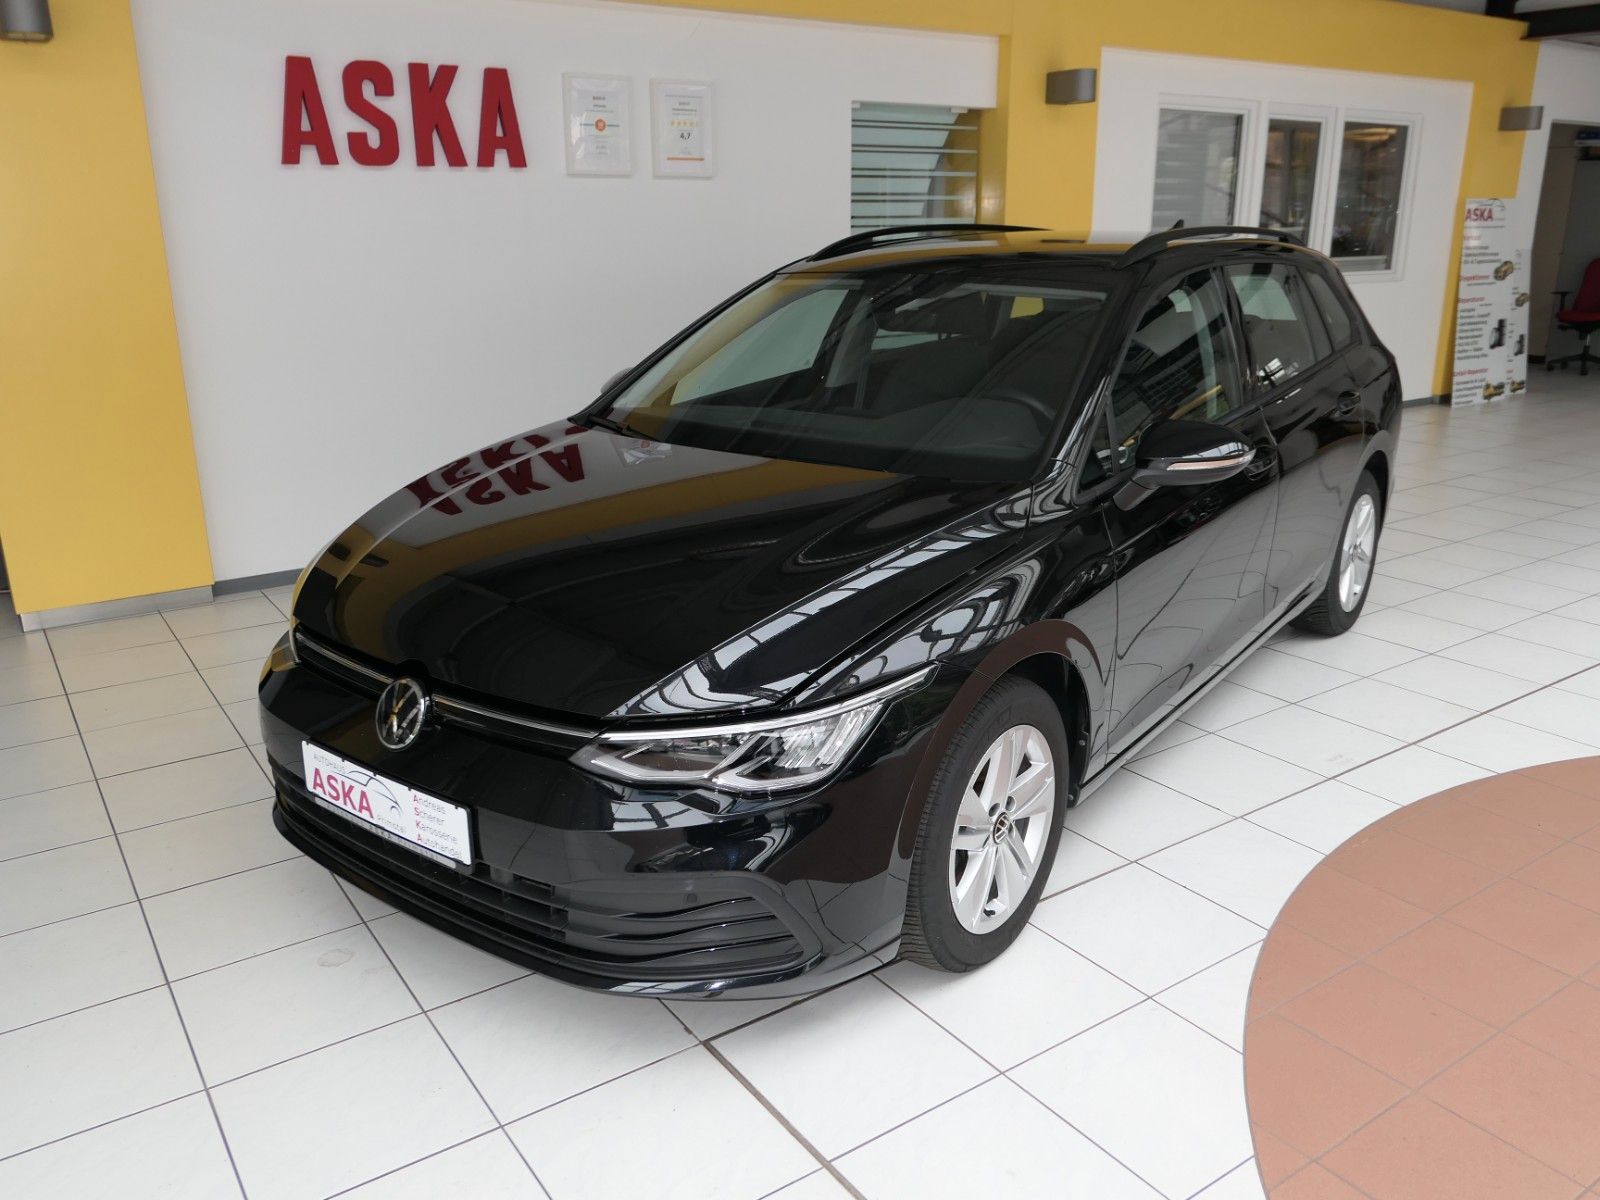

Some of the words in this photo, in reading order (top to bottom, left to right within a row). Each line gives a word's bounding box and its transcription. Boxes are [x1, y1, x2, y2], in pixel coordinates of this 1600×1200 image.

[281, 55, 528, 168] ASKA
[1465, 208, 1493, 221] ASKA
[312, 767, 374, 819] ASKA
[413, 794, 446, 815] Andreas
[416, 819, 458, 846] Karosserie
[417, 833, 463, 857] Autohandel
